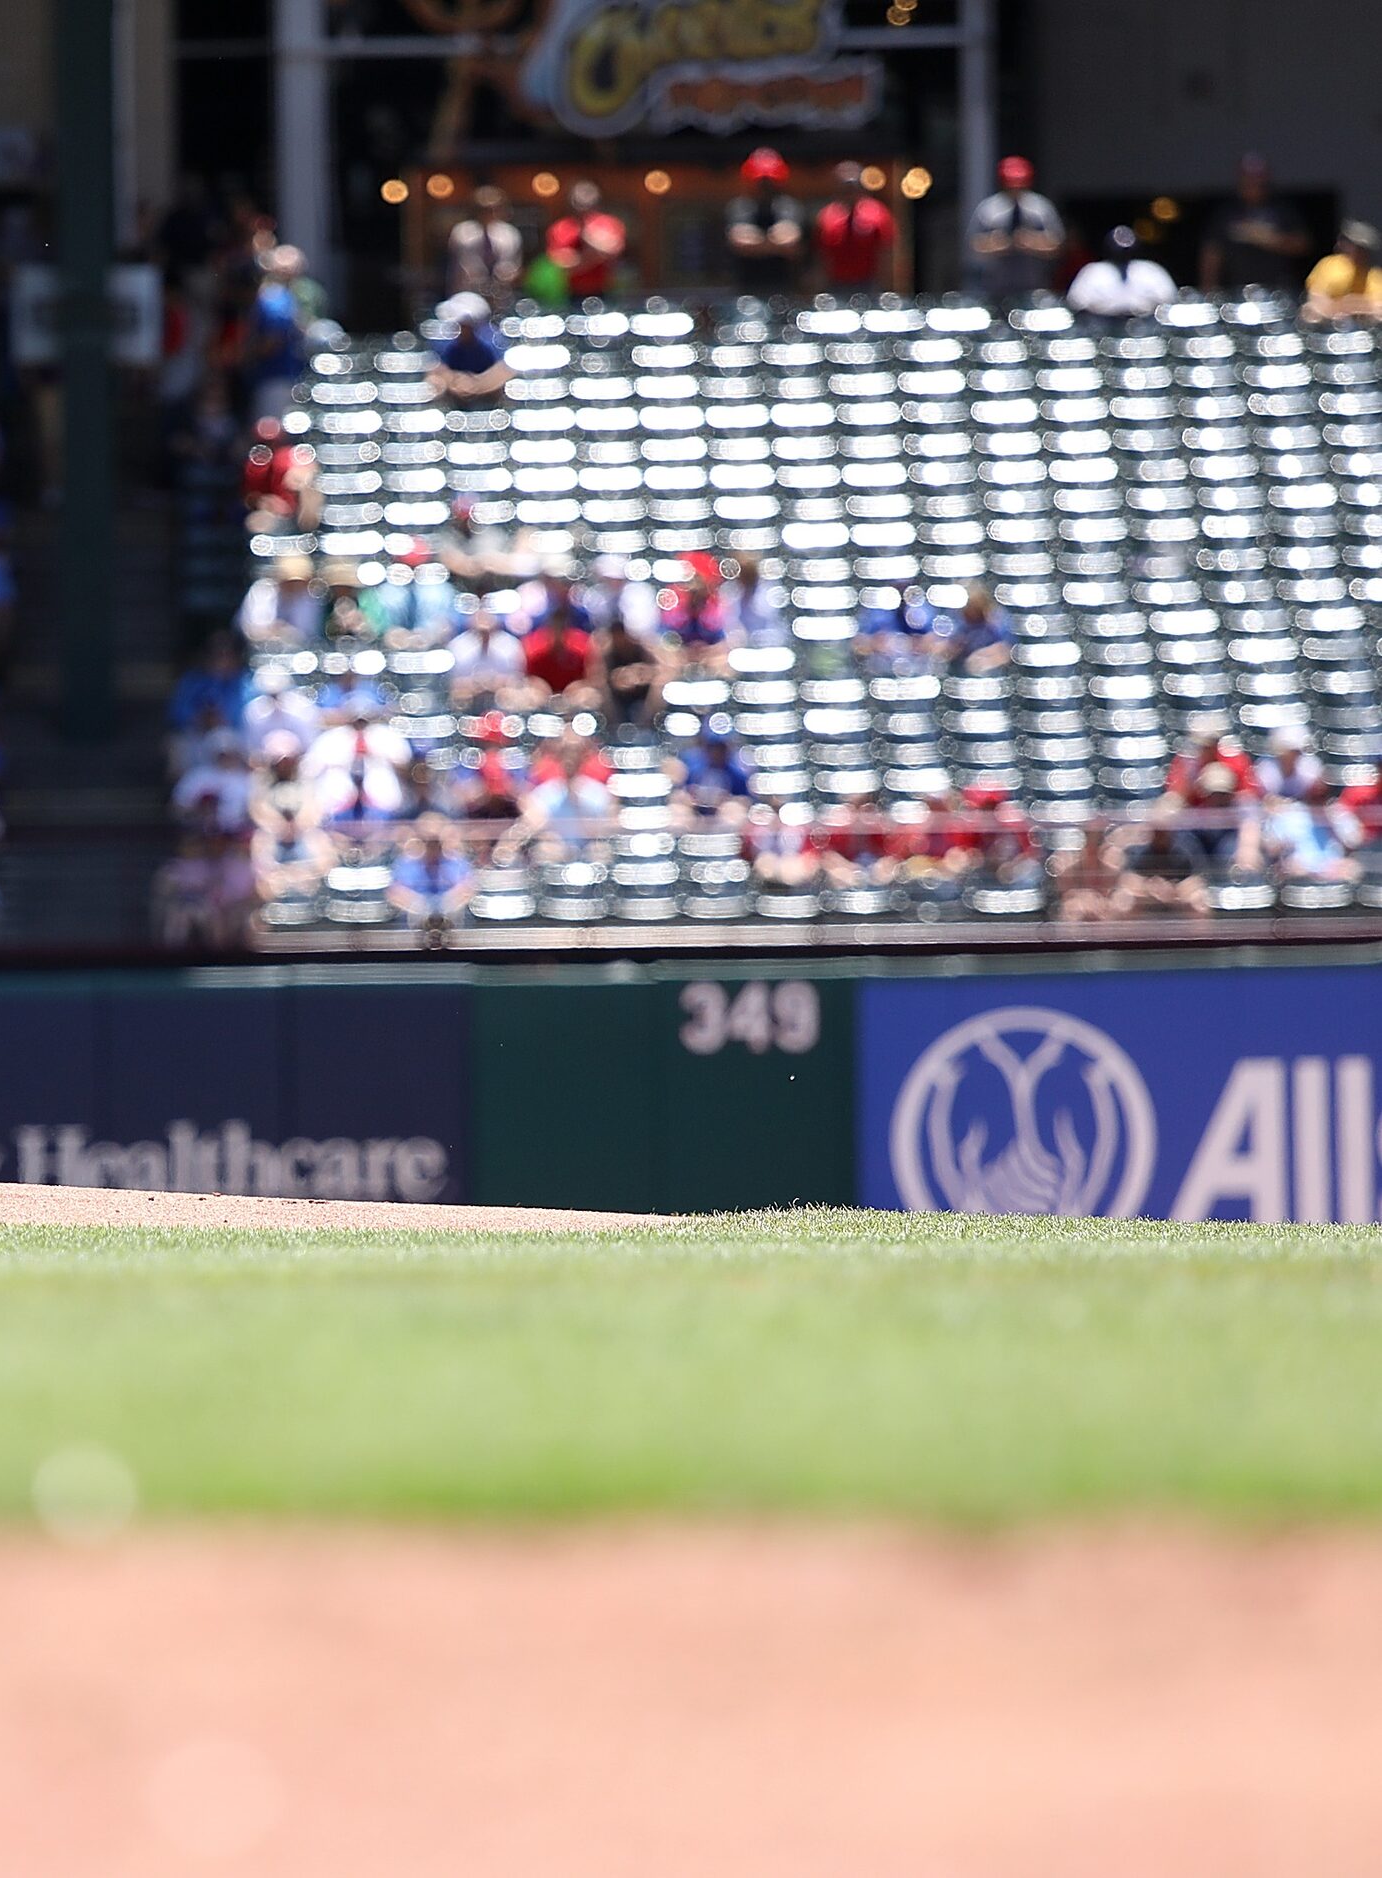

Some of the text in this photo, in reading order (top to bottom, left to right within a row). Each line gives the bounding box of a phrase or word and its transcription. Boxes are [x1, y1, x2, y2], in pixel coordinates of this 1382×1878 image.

[679, 979, 821, 1055] 349
[14, 1119, 449, 1201] Healthcare
[1169, 1054, 1382, 1225] All
